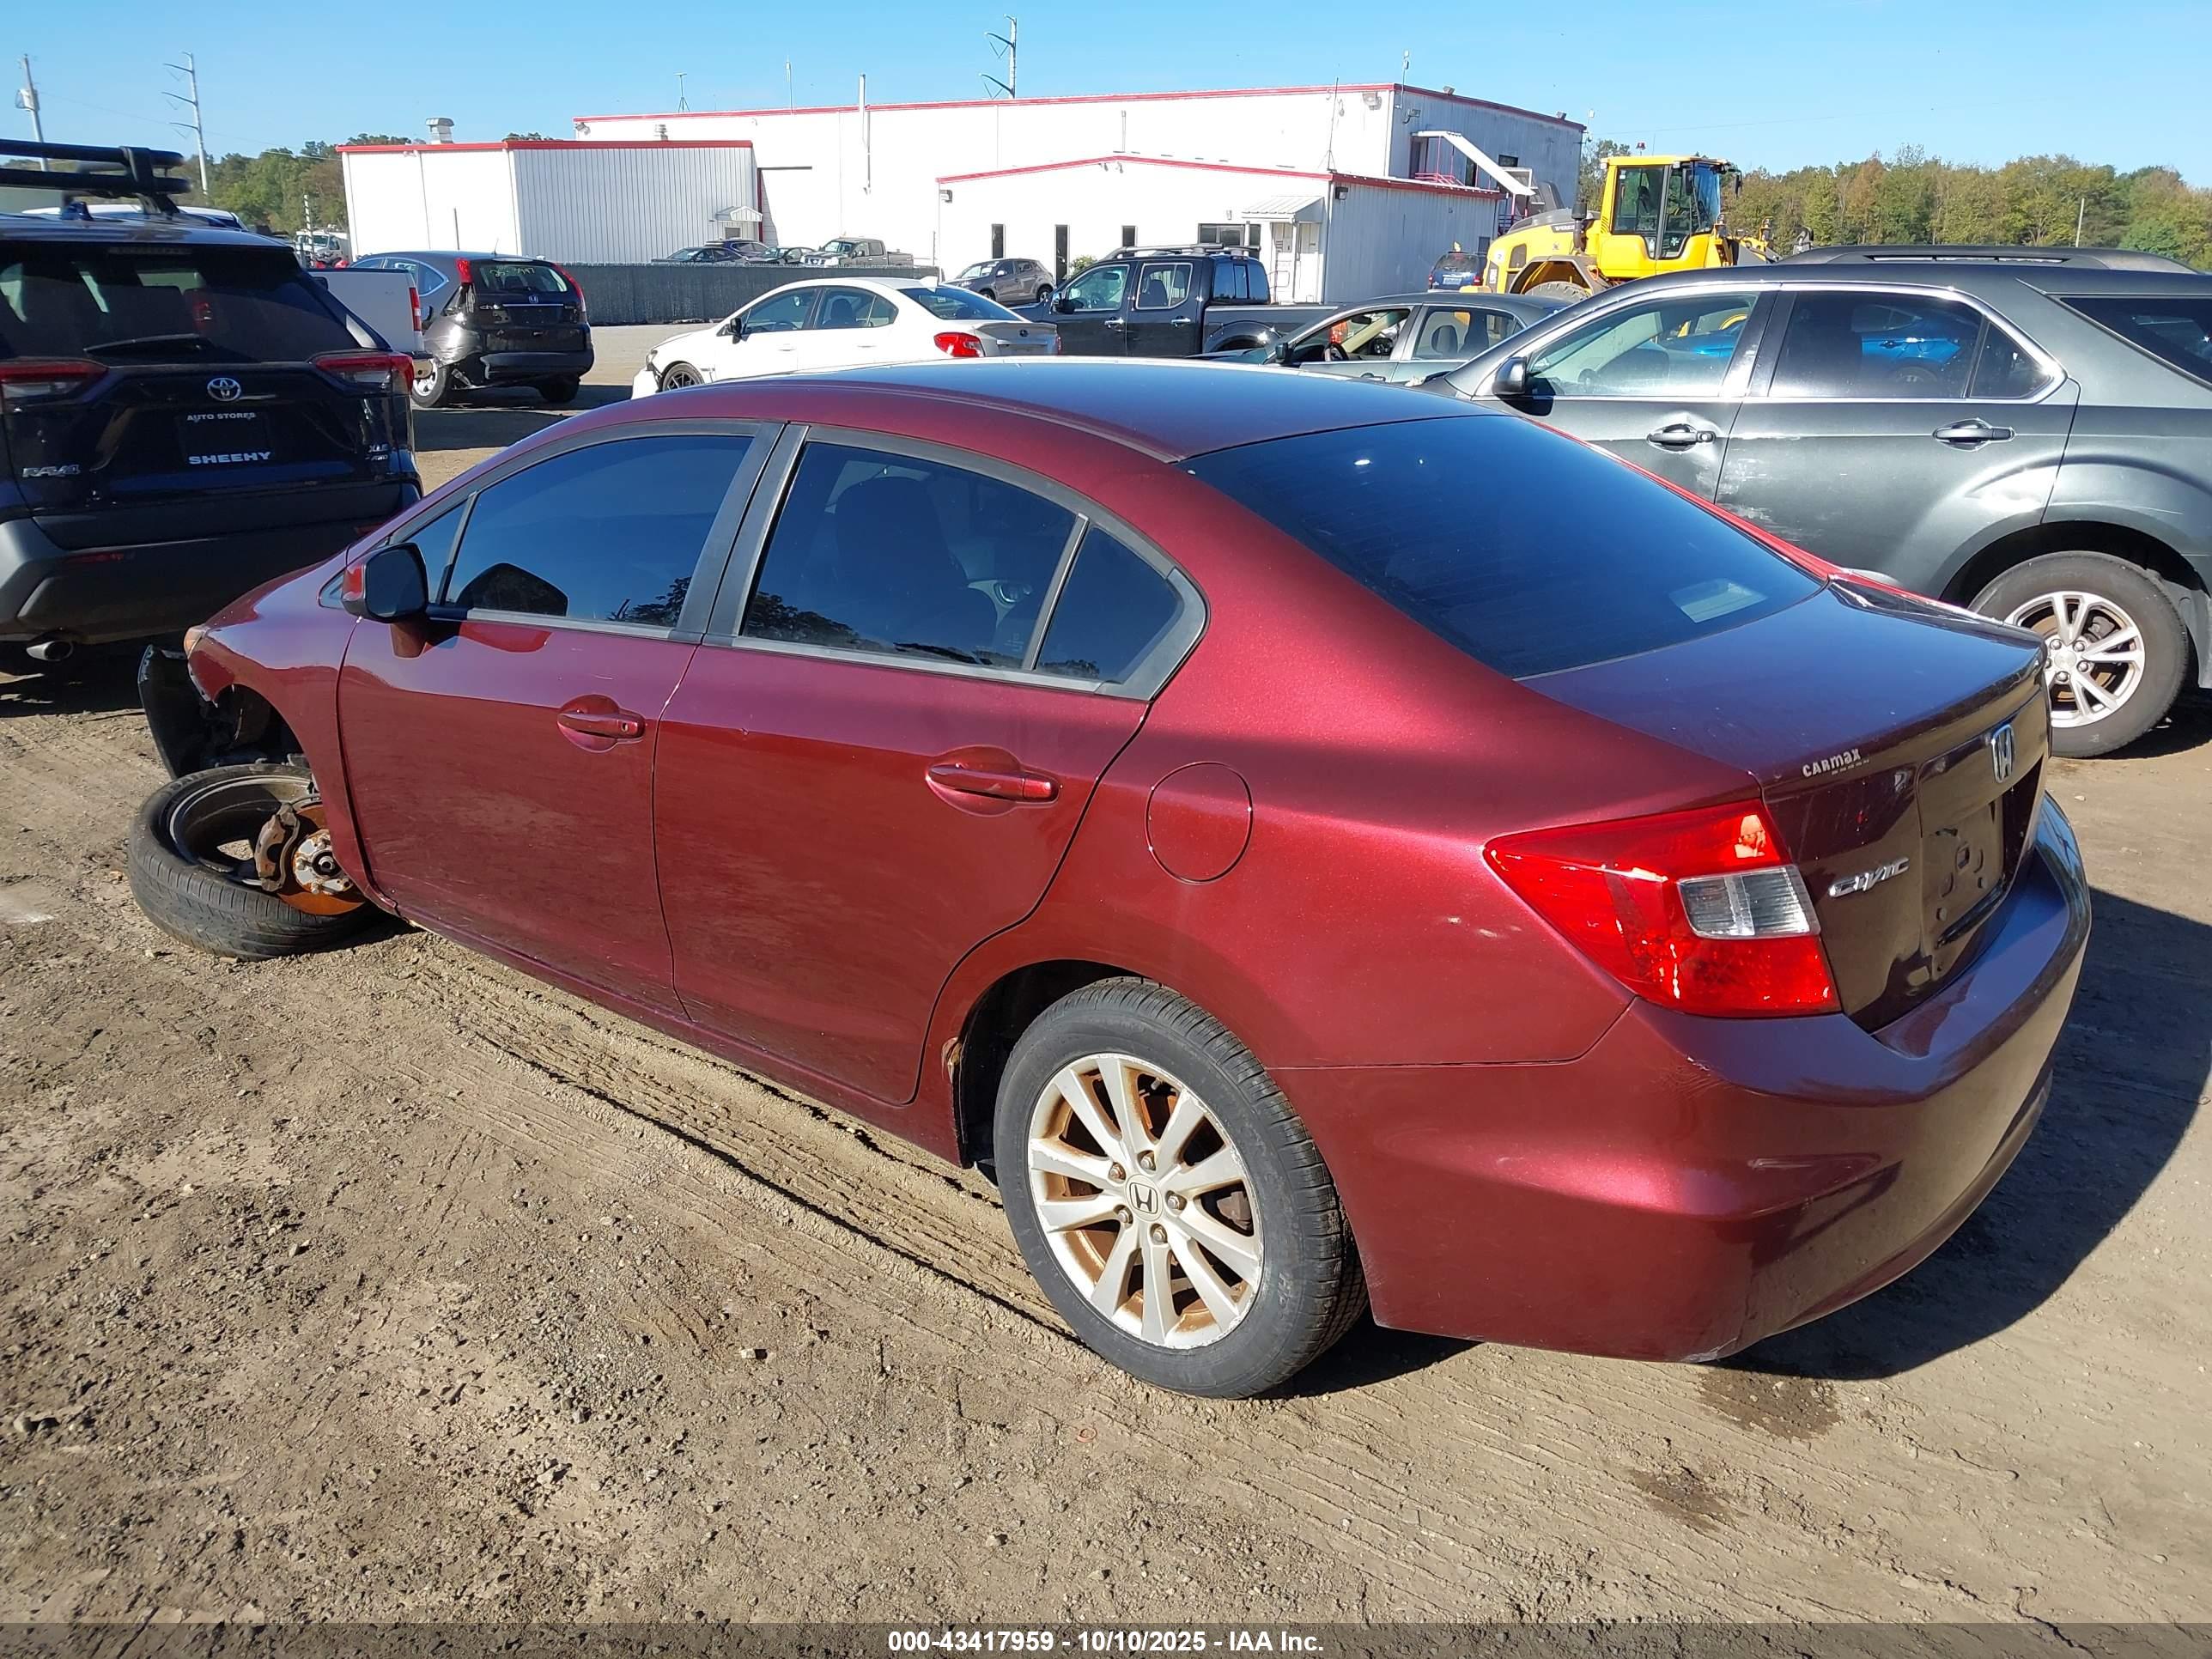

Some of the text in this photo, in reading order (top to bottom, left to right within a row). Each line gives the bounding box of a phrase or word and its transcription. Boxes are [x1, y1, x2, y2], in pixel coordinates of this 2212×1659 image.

[186, 411, 257, 422] AUTO STORES
[188, 451, 271, 465] SHEEHY
[1828, 857, 1910, 898] CIVIC
